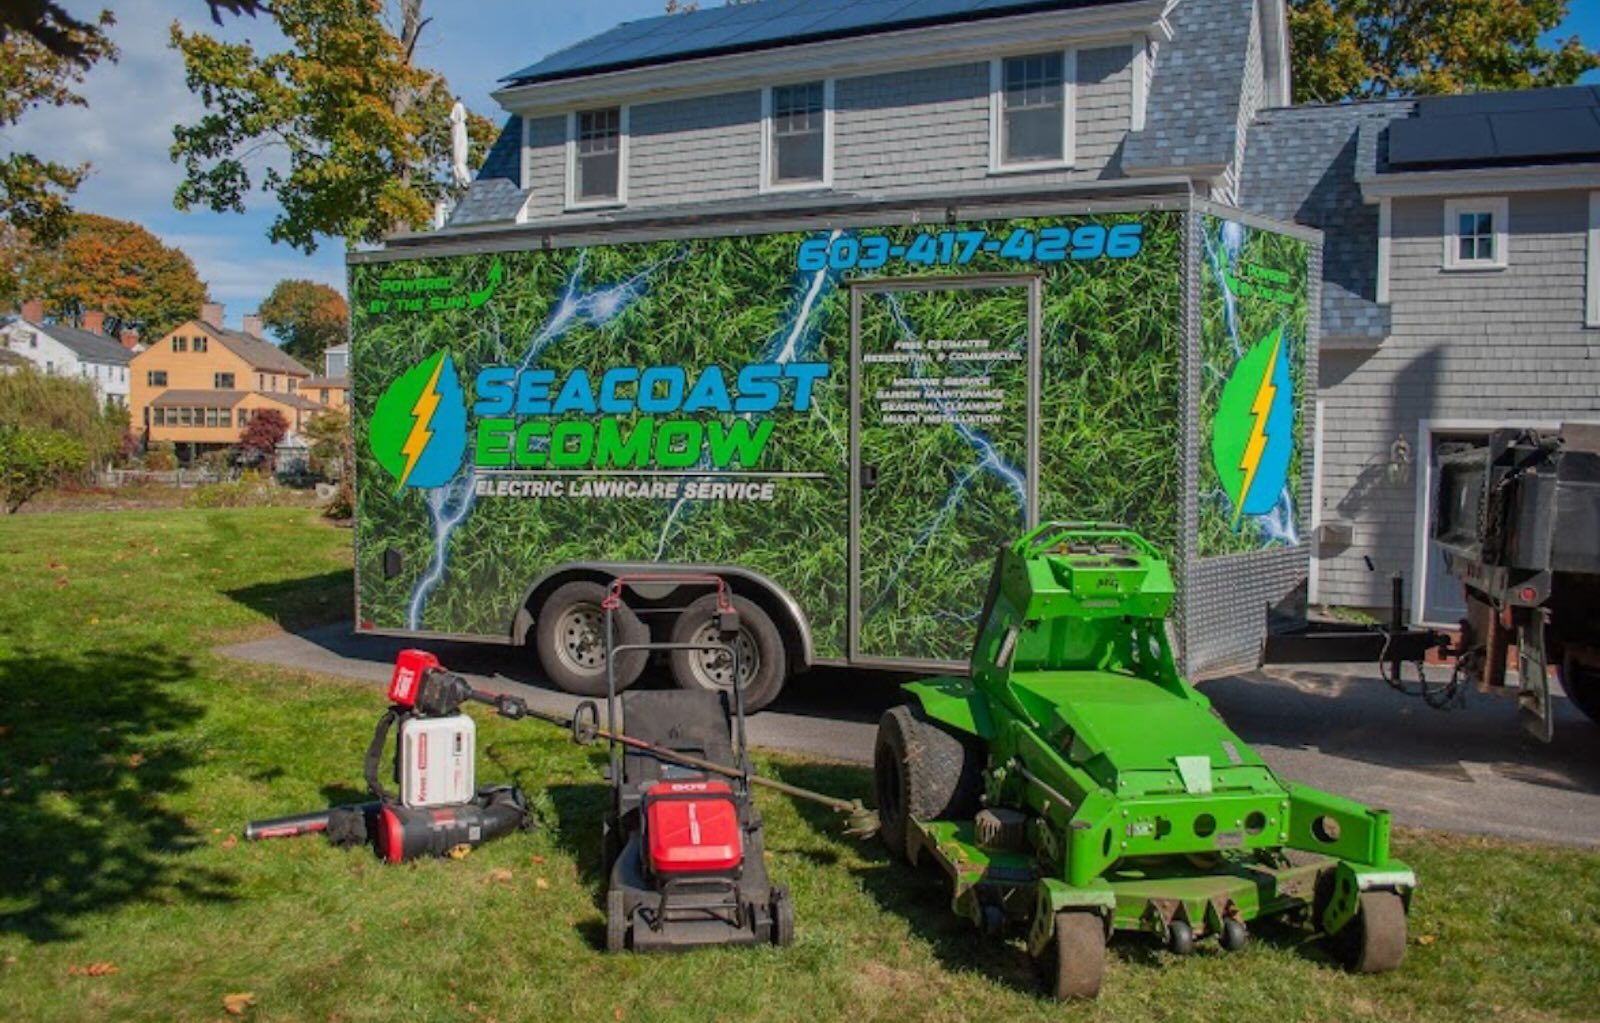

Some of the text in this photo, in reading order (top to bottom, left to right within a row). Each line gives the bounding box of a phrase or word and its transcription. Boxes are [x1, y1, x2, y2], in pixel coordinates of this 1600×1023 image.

[799, 223, 1144, 271] 603-417-4296
[380, 277, 456, 292] POWERED
[370, 300, 390, 313] BY
[396, 299, 424, 312] THE
[949, 351, 1023, 361] COMMERCIAL
[473, 362, 829, 415] SEACOAST
[880, 402, 939, 412] SEASONAL
[883, 414, 1002, 424] MULCH INSTALLATION
[475, 480, 775, 501] ELECTRIC LAWNCARE SERVICE
